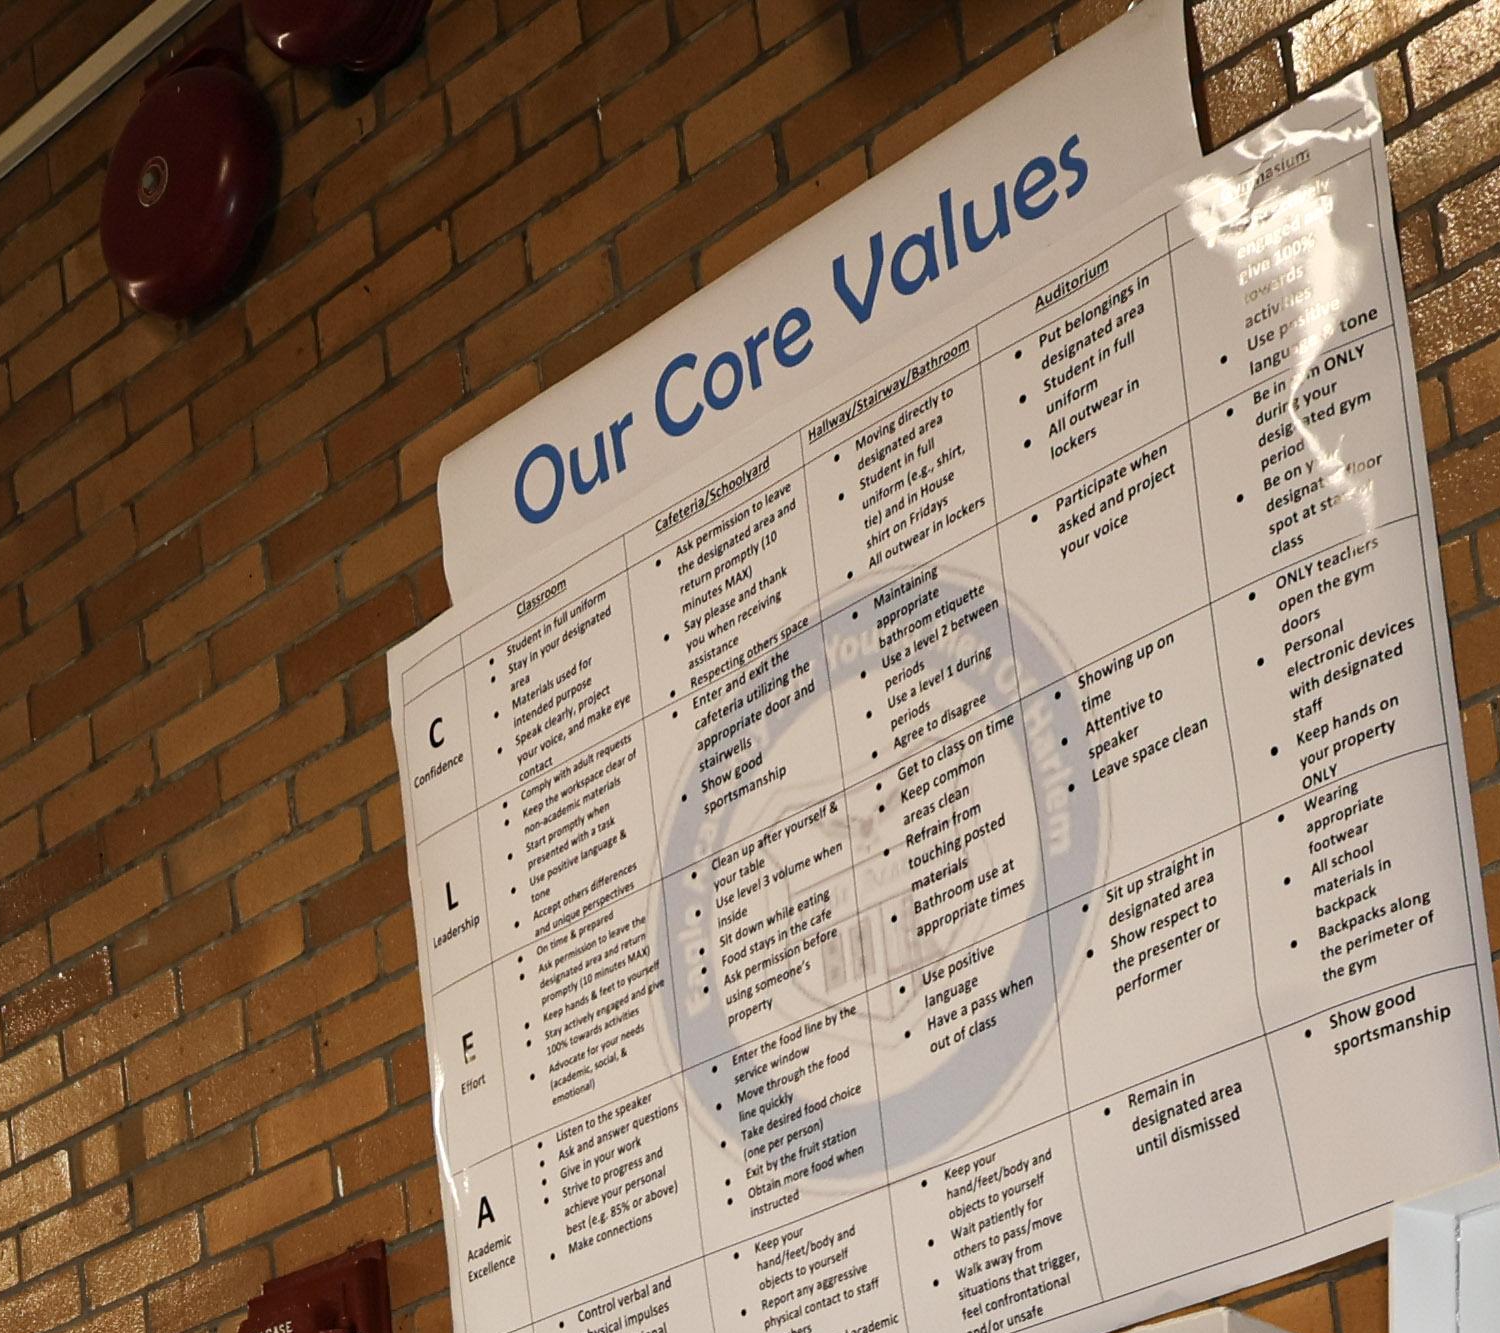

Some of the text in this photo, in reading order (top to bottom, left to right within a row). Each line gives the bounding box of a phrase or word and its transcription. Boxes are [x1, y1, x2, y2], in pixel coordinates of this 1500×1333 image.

[1033, 258, 1110, 314] Auditorium
[513, 416, 635, 522] Our
[656, 309, 813, 436] Core
[829, 145, 1088, 321] Values
[1037, 275, 1150, 348] Put belongings in
[1040, 303, 1145, 370] designated area
[1041, 328, 1135, 392] Student in full
[806, 339, 971, 445] Hallway/Stairway/Bathroom
[1044, 378, 1099, 415] uniform
[1047, 378, 1140, 438] All outwear in
[854, 387, 954, 451] Moving directly to
[856, 414, 943, 470] designated area
[1049, 426, 1098, 460] lockers
[858, 436, 935, 490] Student in full
[861, 444, 966, 509] uniform (e.g., shirt,
[1054, 444, 1168, 512] Participate when
[653, 454, 771, 536] Cafeteria/Schoolyard
[862, 471, 955, 529] tie) and in House
[1057, 462, 1176, 534] asked and project
[865, 495, 949, 549] shirt on Fridays
[867, 496, 986, 569] All outwear in lockers
[1058, 513, 1129, 560] your voice
[515, 578, 568, 619] Classroom
[1076, 632, 1175, 689] Showing up on
[1283, 617, 1344, 656] Personal
[1285, 617, 1416, 677] electronic devices
[1287, 641, 1404, 699] with designated
[1079, 689, 1112, 714] time
[1083, 689, 1164, 736] Attentive to
[1291, 695, 1323, 722] staff
[1295, 695, 1400, 746] Keep hands on
[427, 716, 445, 748] C
[1087, 725, 1139, 759] speaker
[1090, 717, 1209, 782] Leave space clean
[1298, 719, 1396, 771] your property
[412, 752, 464, 789] Confidence
[699, 751, 763, 793] Show good
[702, 765, 787, 814] sportsmanship
[1300, 762, 1338, 789] ONLY
[1302, 781, 1360, 811] Wearing
[1305, 794, 1384, 834] appropriate
[1306, 822, 1369, 854] footwear
[1310, 839, 1374, 876] All school
[444, 880, 460, 911] L
[1101, 846, 1215, 903] Sit up straight in
[1107, 871, 1215, 926] designated area
[1312, 858, 1392, 896] materials in
[1109, 895, 1218, 950] Show respect to
[1314, 884, 1378, 918] backpack
[1316, 891, 1432, 939] Backpacks along
[431, 914, 481, 949] Leadership
[1111, 917, 1221, 973] the presenter or
[1318, 908, 1435, 960] the perimeter of
[1114, 959, 1183, 1000] performer
[1320, 954, 1377, 982] the gym
[1328, 985, 1416, 1029] Show good
[1332, 1004, 1452, 1056] sportsmanship
[460, 1030, 477, 1064] E
[459, 1073, 486, 1095] Effort
[1126, 1072, 1196, 1108] Remain in
[1130, 1081, 1243, 1132] designated area
[1134, 1104, 1241, 1156] until dismissed
[476, 1195, 496, 1229] A
[466, 1233, 512, 1262] Academic
[466, 1254, 516, 1282] Excellence
[576, 1274, 672, 1322] Control verbal and
[622, 1301, 670, 1327] impulses
